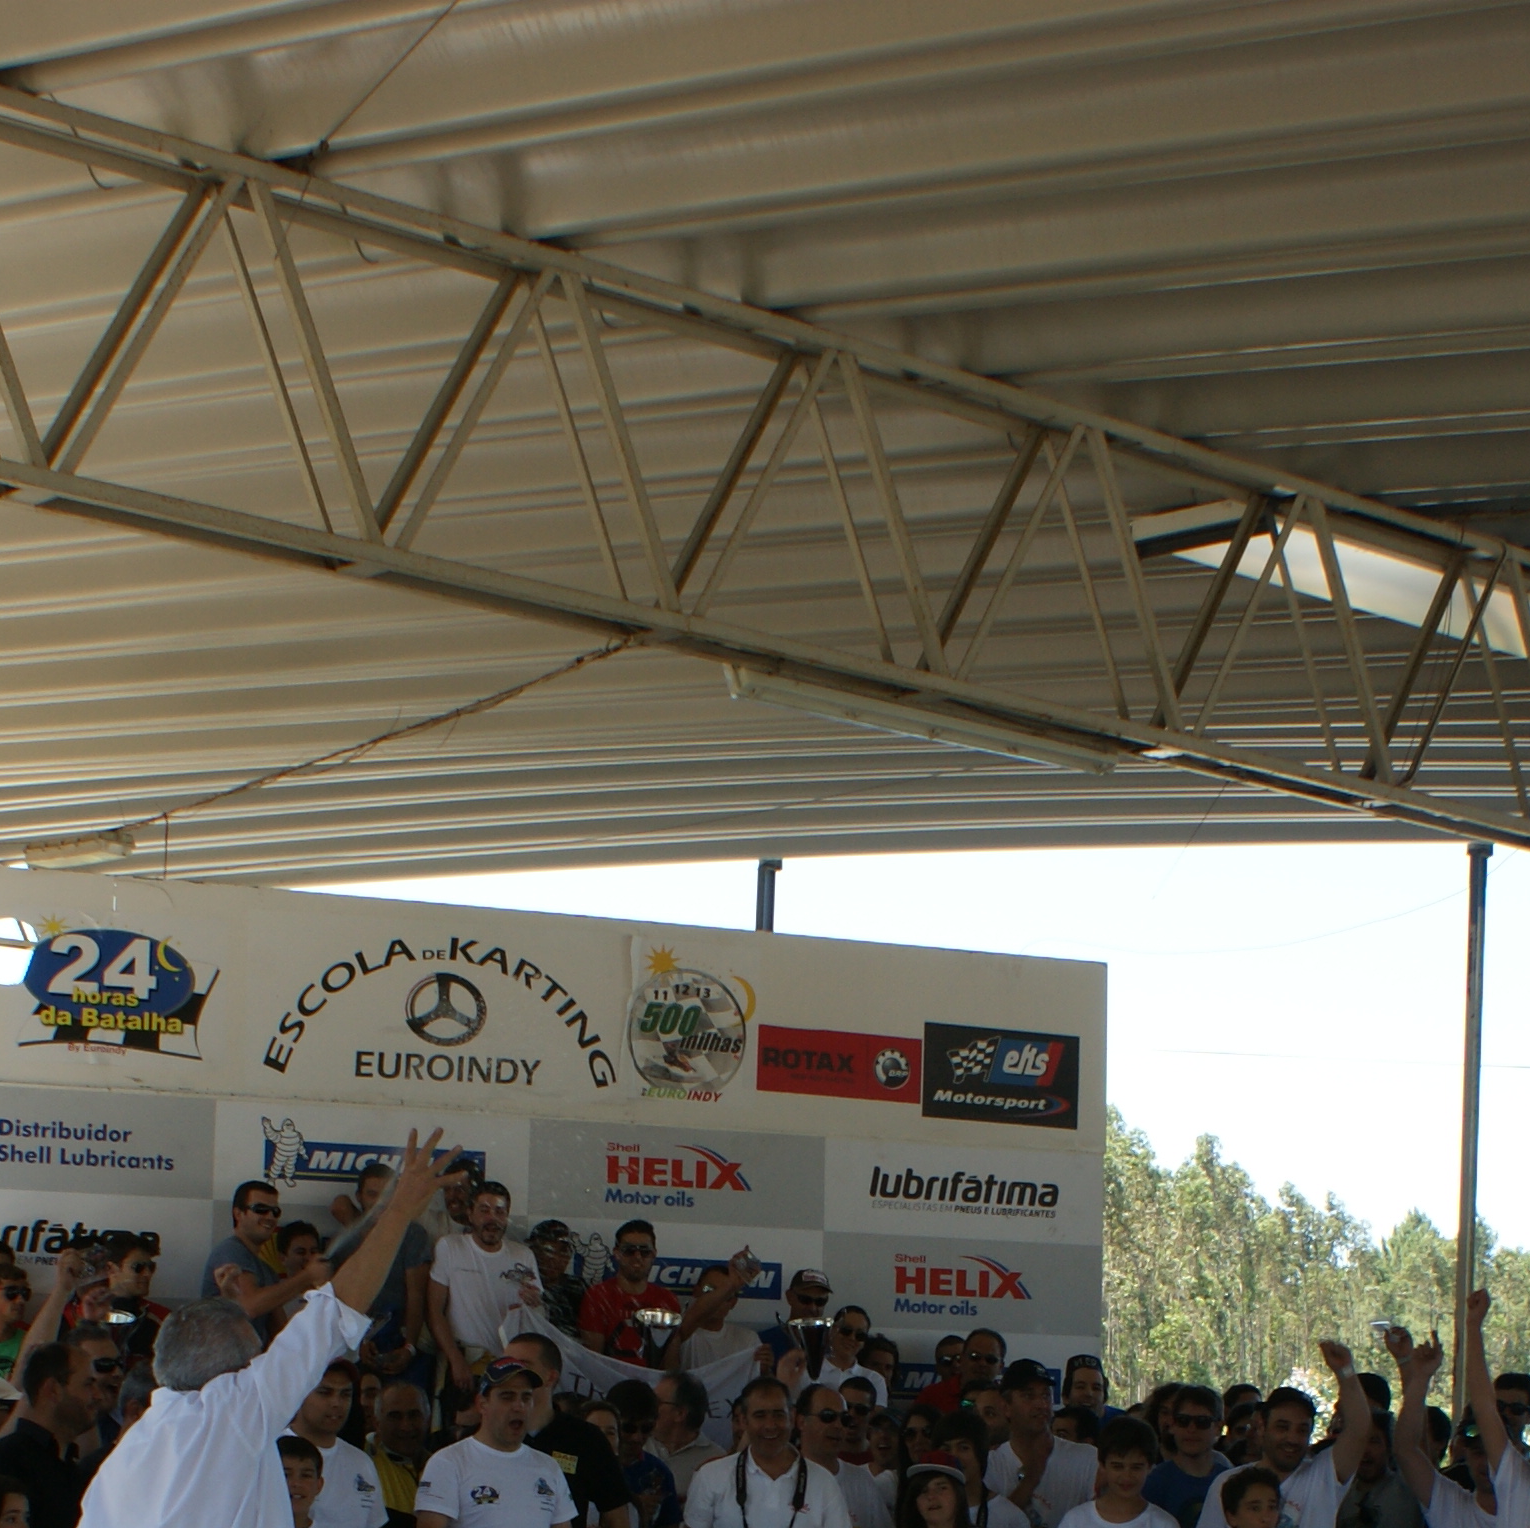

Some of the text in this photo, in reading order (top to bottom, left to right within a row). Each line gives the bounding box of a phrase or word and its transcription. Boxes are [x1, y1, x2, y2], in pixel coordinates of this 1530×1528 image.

[46, 933, 157, 999] 24
[72, 987, 140, 1007] horas
[674, 983, 690, 995] 12
[39, 1006, 183, 1033] da Batalha
[263, 936, 617, 1089] ESCOLA DE KARTING
[640, 1002, 702, 1036] 500
[679, 1031, 743, 1054] milhas
[355, 1050, 542, 1086] EUROINDY
[762, 1047, 854, 1073] ROTAX
[648, 1086, 722, 1102] EUROINDY
[933, 1090, 1047, 1111] Motorsport
[606, 1142, 639, 1153] Shell
[60, 1148, 174, 1171] Lubricants
[606, 1156, 747, 1191] HELIX
[605, 1188, 694, 1208] Motor oils
[953, 1206, 982, 1216] PNEUS
[983, 1206, 990, 1216] E
[991, 1207, 1056, 1219] LUBRIFICANTES
[894, 1253, 926, 1263] Shell
[894, 1266, 1029, 1300] HELIX
[894, 1298, 977, 1316] Motor oils
